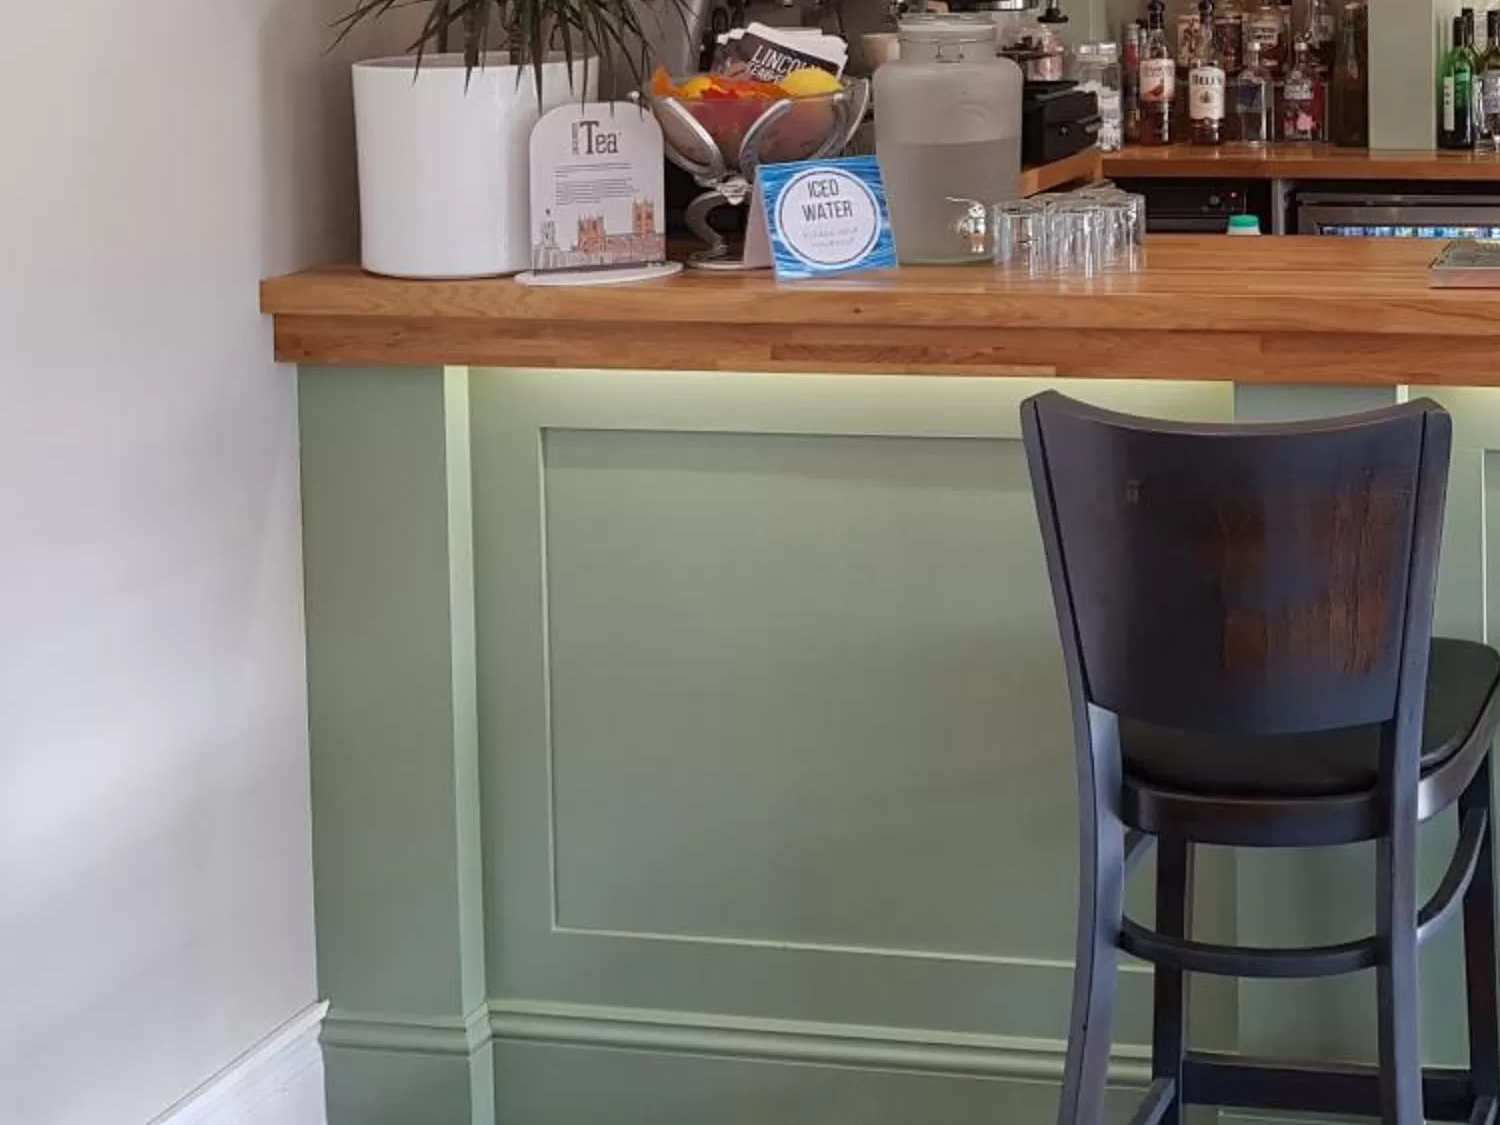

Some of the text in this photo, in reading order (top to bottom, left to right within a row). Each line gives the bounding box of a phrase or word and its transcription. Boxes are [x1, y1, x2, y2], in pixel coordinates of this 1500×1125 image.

[751, 43, 816, 76] LINCO
[579, 120, 618, 155] Tea
[807, 178, 839, 198] ICED
[801, 200, 854, 222] WATER
